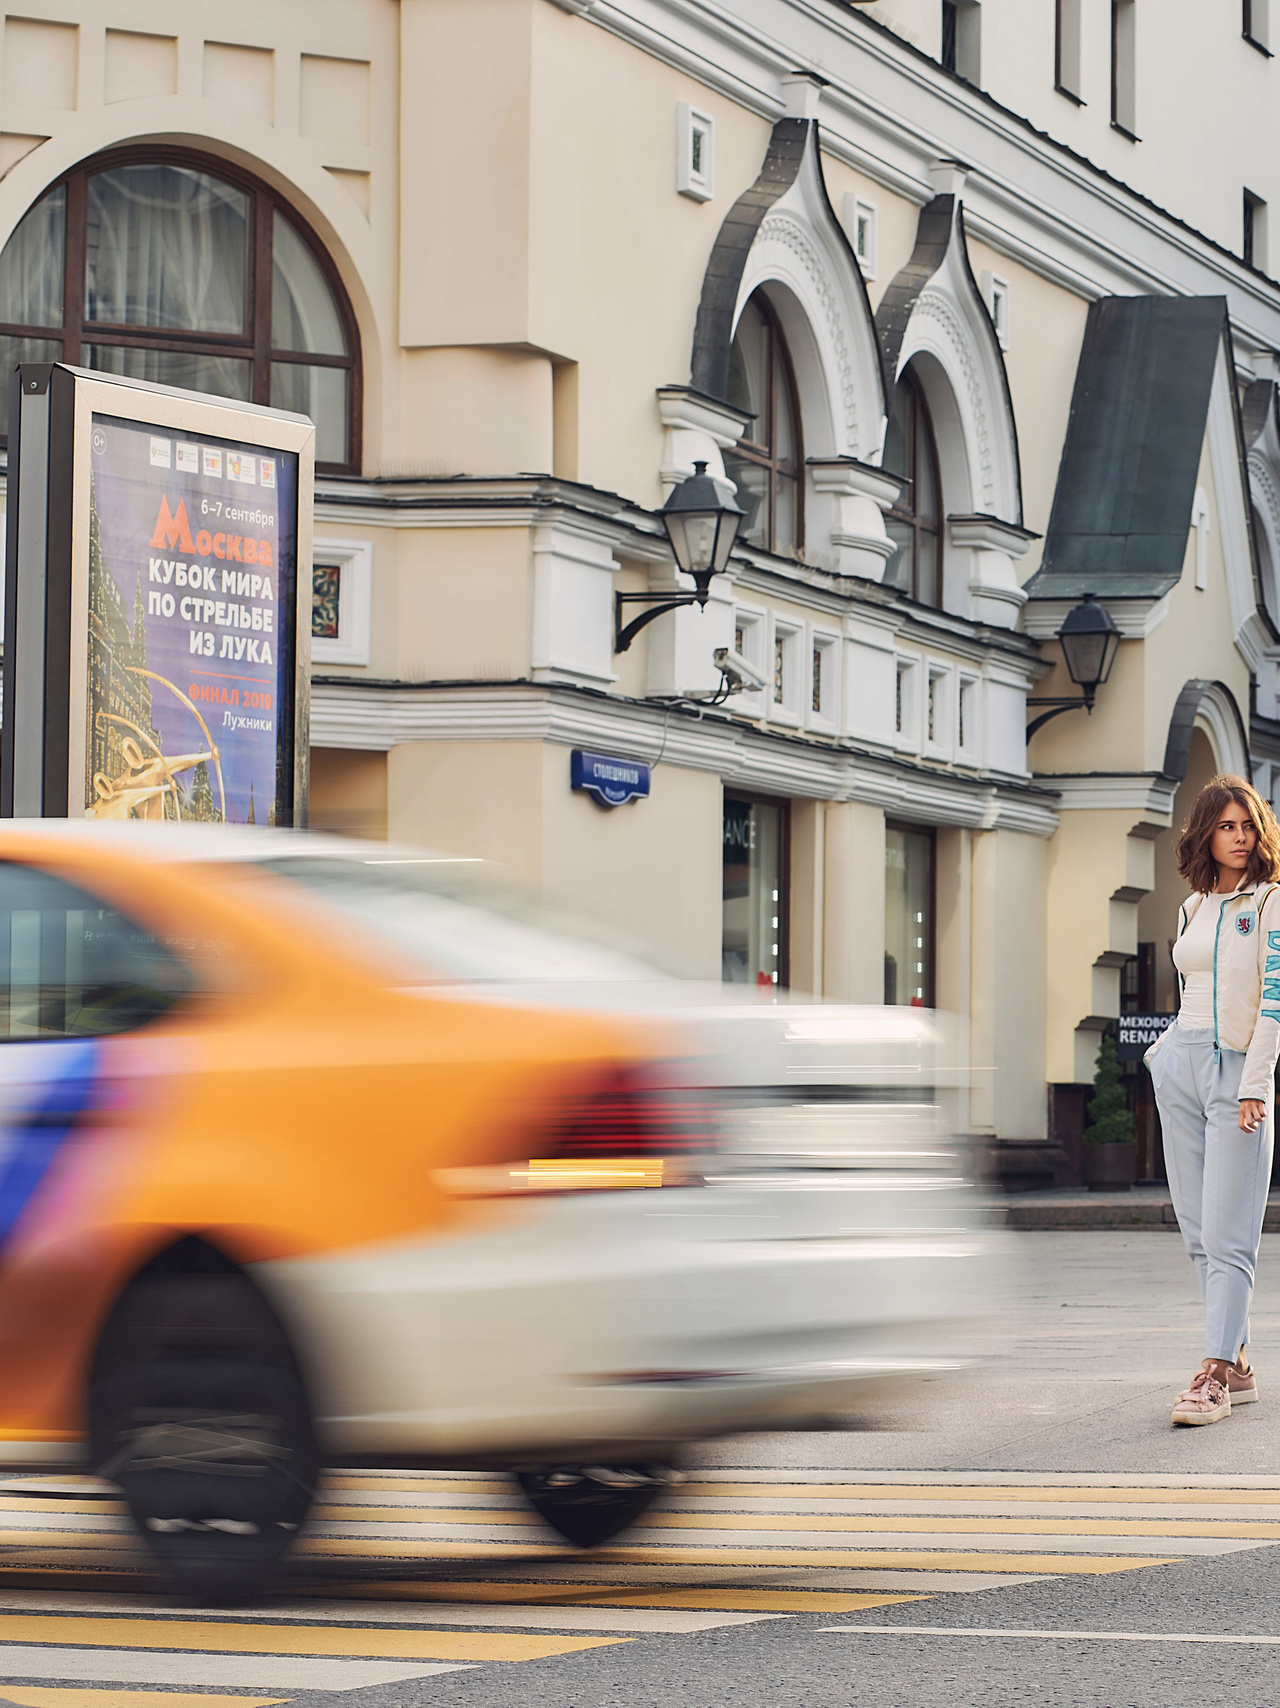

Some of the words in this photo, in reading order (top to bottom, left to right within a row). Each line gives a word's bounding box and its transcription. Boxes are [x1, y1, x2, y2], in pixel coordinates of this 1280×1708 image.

[93, 434, 105, 447] 0+
[149, 493, 274, 568] Москва
[225, 507, 274, 529] сентября
[149, 558, 217, 592] КУБОК
[221, 569, 274, 601] МИРА
[148, 591, 176, 618] ПО
[179, 596, 273, 633] СТРЕЛЬБЕ
[189, 630, 215, 657] ИЗ
[219, 634, 273, 665] ЛУКА
[188, 683, 240, 706] ФИНАЛ
[243, 690, 272, 711] 2019
[222, 710, 272, 732] Лужники
[592, 762, 640, 785] СТОЛЕШНИКОВ
